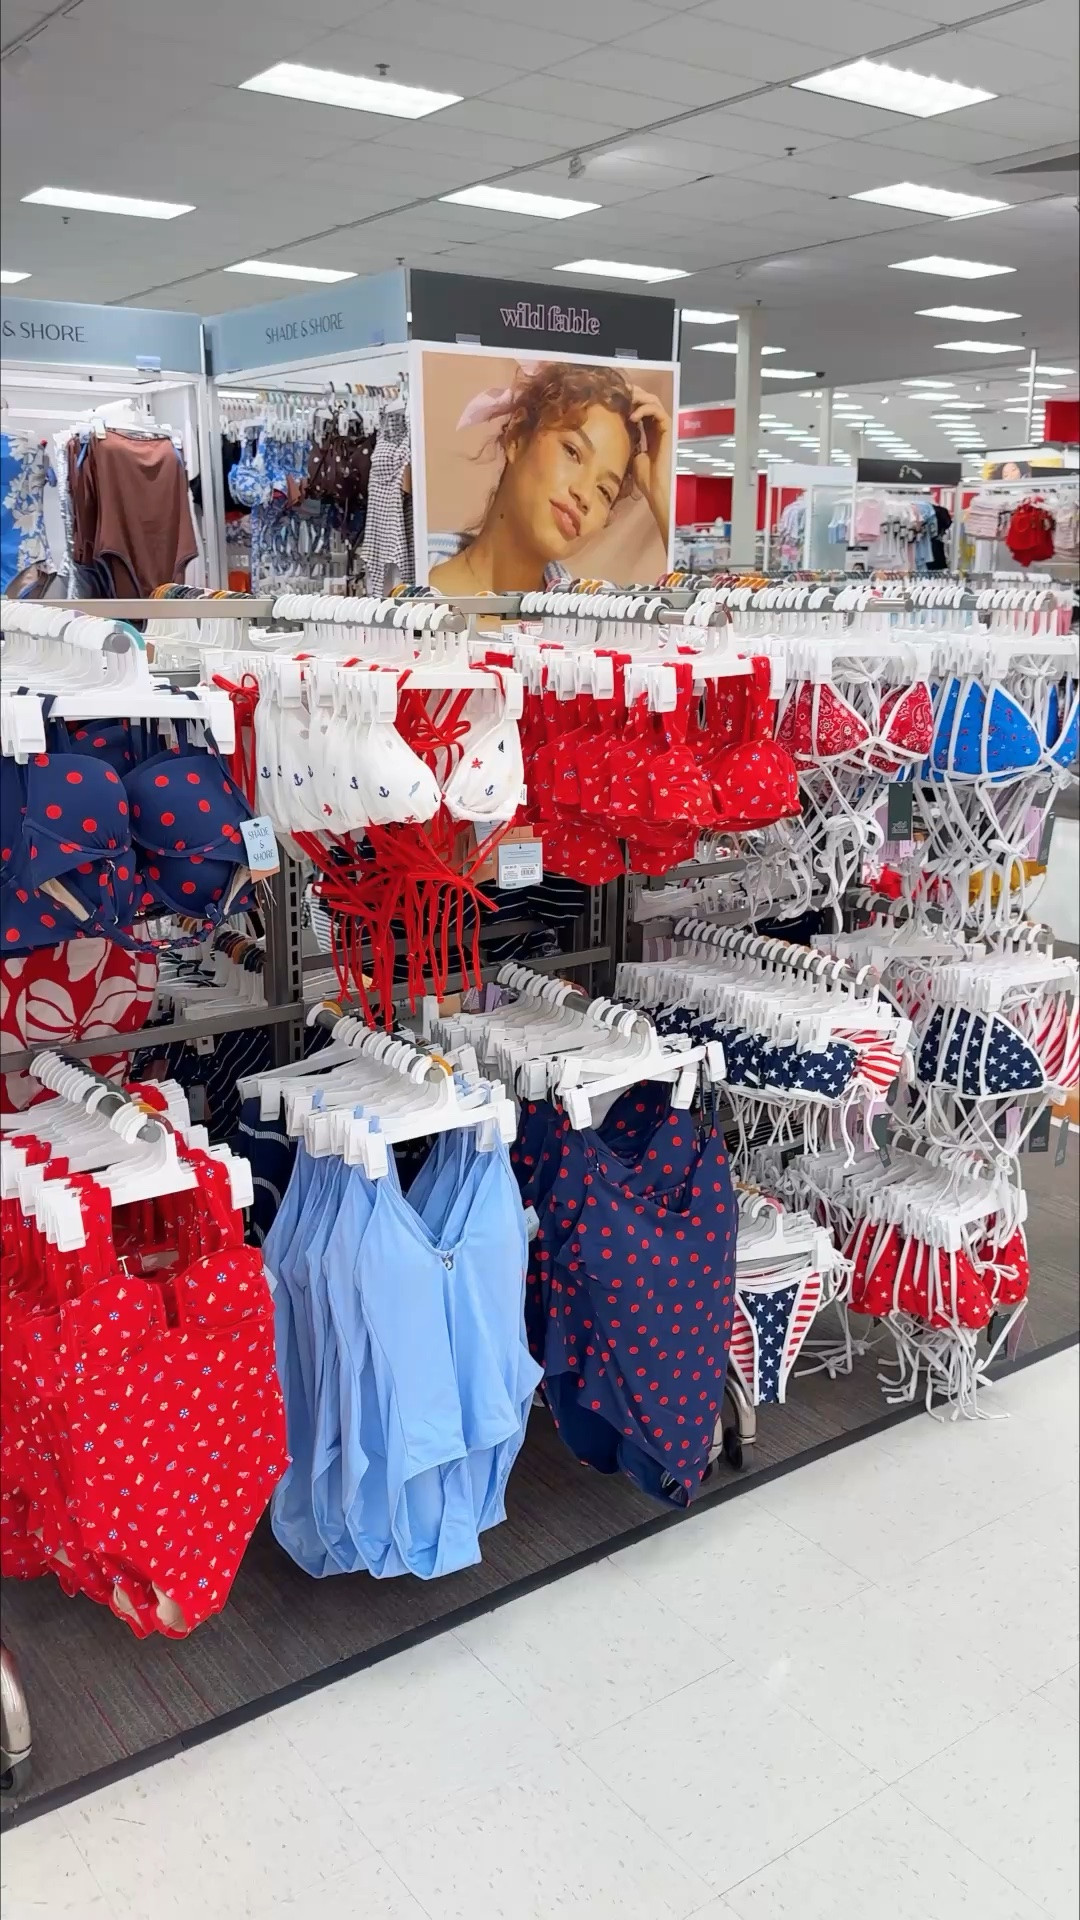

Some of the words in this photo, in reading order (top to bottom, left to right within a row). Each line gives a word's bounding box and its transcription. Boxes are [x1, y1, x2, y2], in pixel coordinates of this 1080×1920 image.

[500, 302, 545, 330] wild
[548, 305, 601, 335] fable
[2, 319, 16, 337] &
[20, 322, 88, 343] SHORE
[265, 321, 299, 344] SHADE
[301, 320, 308, 337] &
[309, 312, 345, 336] SHORE
[248, 827, 269, 840] SHADE
[259, 840, 265, 849] &
[253, 849, 273, 862] SHORE
